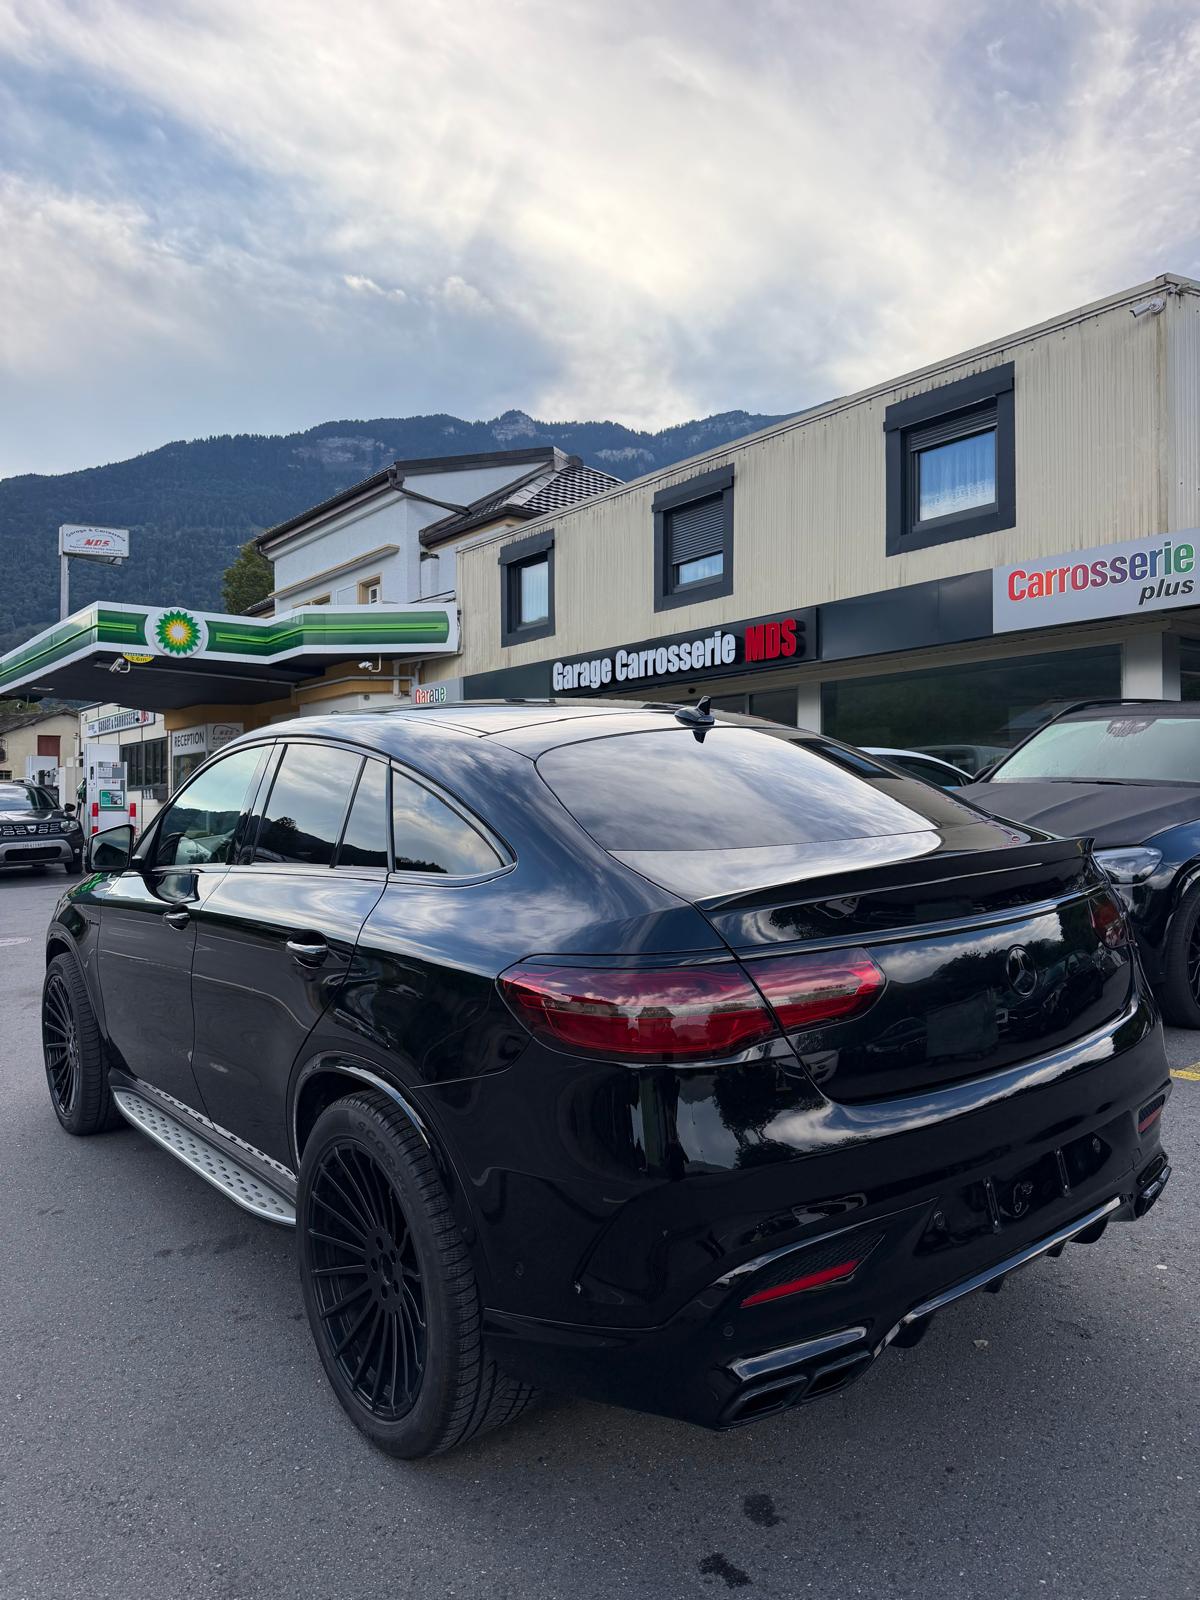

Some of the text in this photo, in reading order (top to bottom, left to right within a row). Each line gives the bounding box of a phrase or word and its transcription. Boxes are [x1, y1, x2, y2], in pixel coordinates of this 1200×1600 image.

[1008, 541, 1194, 601] Carrosserie
[1138, 579, 1194, 605] plus
[553, 619, 797, 691] Garage Carrosserie MDS
[174, 731, 205, 747] RECEPTION
